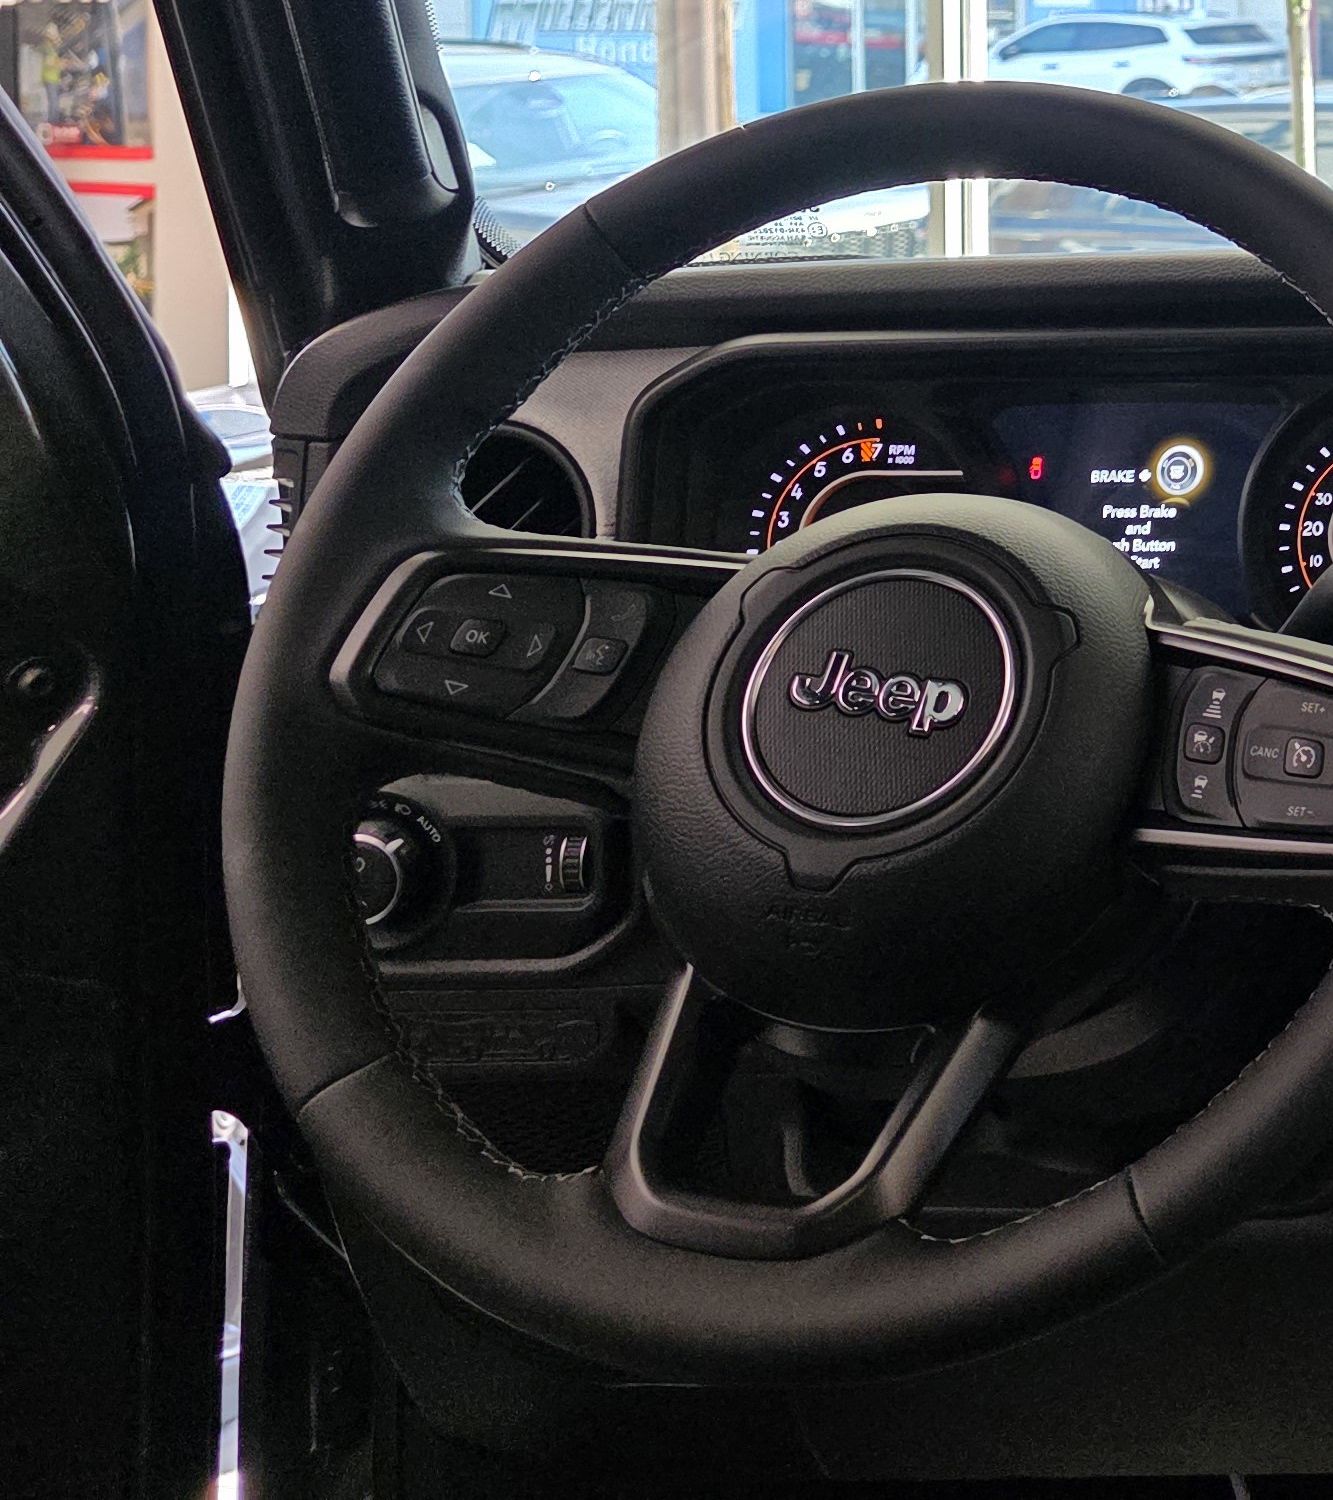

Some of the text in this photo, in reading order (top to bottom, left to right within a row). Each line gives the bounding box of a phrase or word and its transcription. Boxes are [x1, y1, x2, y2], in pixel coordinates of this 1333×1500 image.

[842, 448, 854, 463] 6
[872, 443, 883, 460] 7
[888, 444, 916, 456] RPM
[813, 461, 827, 477] 5
[1091, 469, 1136, 484] BRAKE
[791, 483, 803, 500] 4
[1315, 492, 1333, 506] 30
[777, 511, 790, 528] 3
[1102, 504, 1178, 519] Press Brake
[1125, 521, 1152, 536] and
[1302, 520, 1324, 537] 20
[1132, 539, 1176, 553] Button
[1309, 554, 1323, 568] 10
[465, 629, 491, 645] OK
[788, 649, 971, 736] Jeep
[1250, 744, 1280, 760] CANC
[415, 815, 442, 845] AUTO
